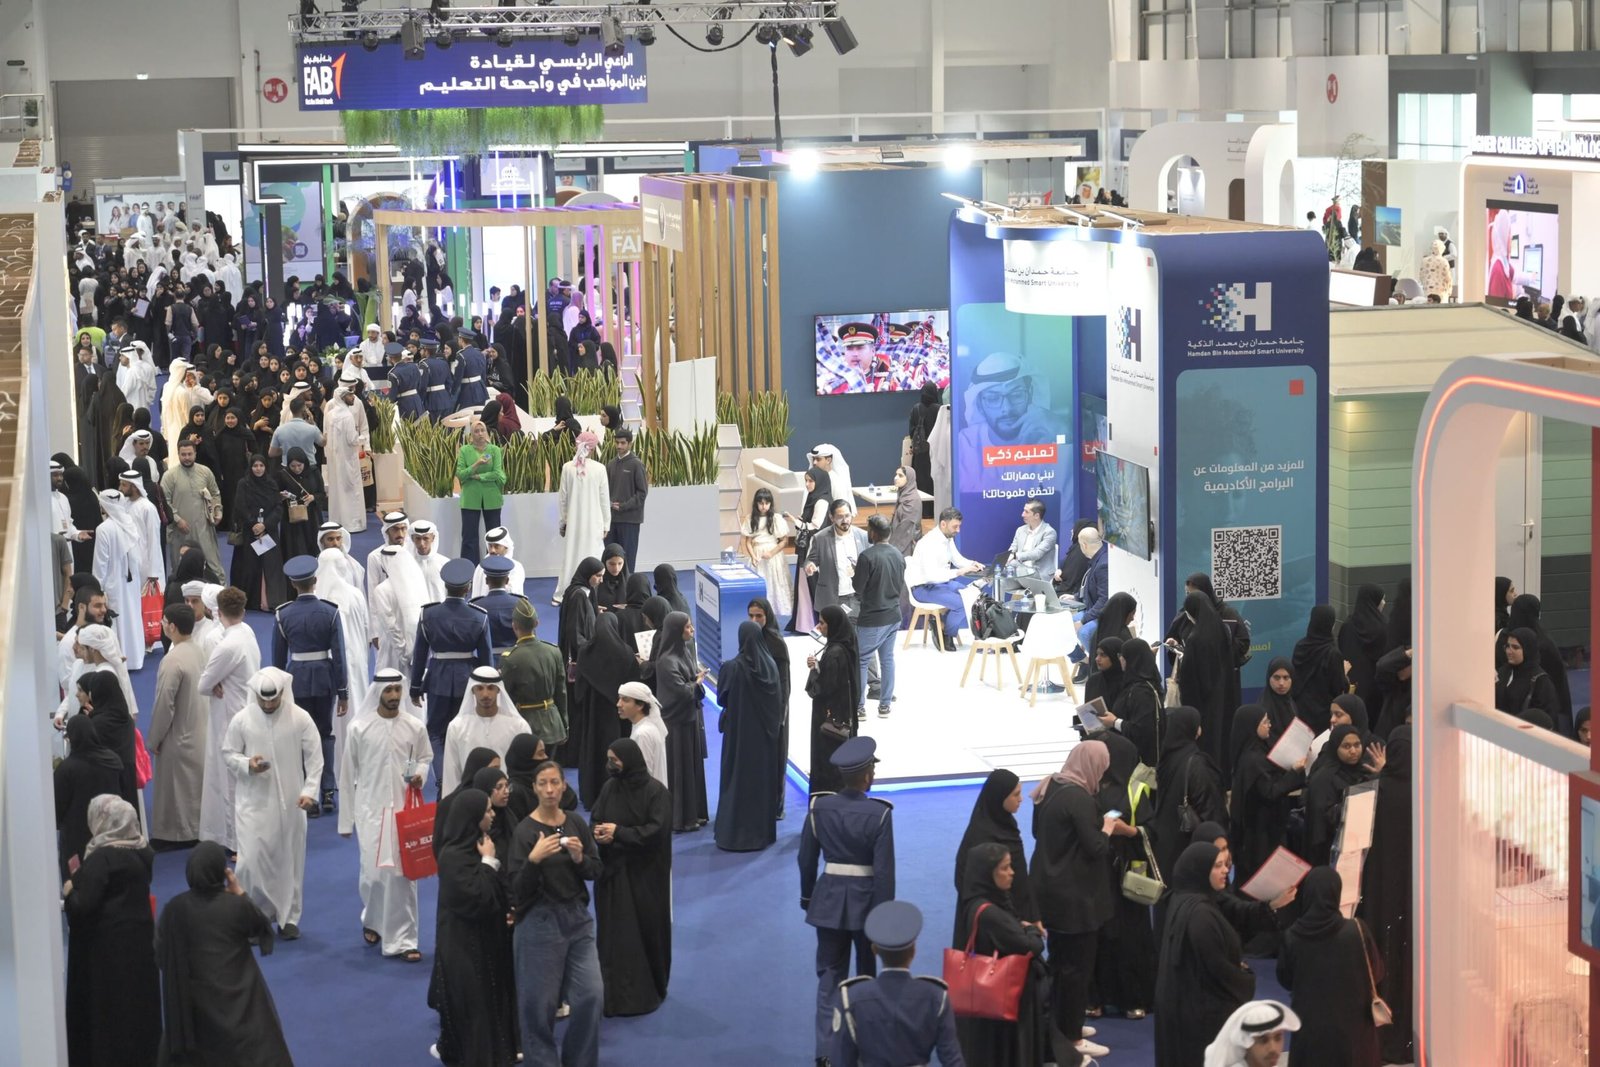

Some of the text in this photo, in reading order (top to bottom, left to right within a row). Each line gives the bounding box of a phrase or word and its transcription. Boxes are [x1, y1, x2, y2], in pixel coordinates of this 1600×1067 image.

[470, 52, 633, 75] الراعي الرئيسي لقيادة
[304, 66, 334, 96] FAB
[420, 76, 496, 95] التعليم
[500, 75, 554, 92] واجهة
[557, 72, 580, 96] في
[583, 73, 628, 91] المواهب
[612, 235, 642, 253] FA
[1188, 340, 1214, 350] الذكية
[1238, 340, 1248, 348] بن
[1250, 338, 1278, 348] حمدان
[1278, 337, 1304, 346] جامعة
[986, 446, 1054, 464] تعليم ذكي
[1002, 470, 1054, 482] نبني مهاراتك
[1194, 460, 1304, 476] للمزيد من المعلومات عن
[983, 486, 1054, 499] لتحقق طموحاتك!
[1204, 476, 1294, 494] البرامج الأكاديمية
[1250, 642, 1271, 652] امس
